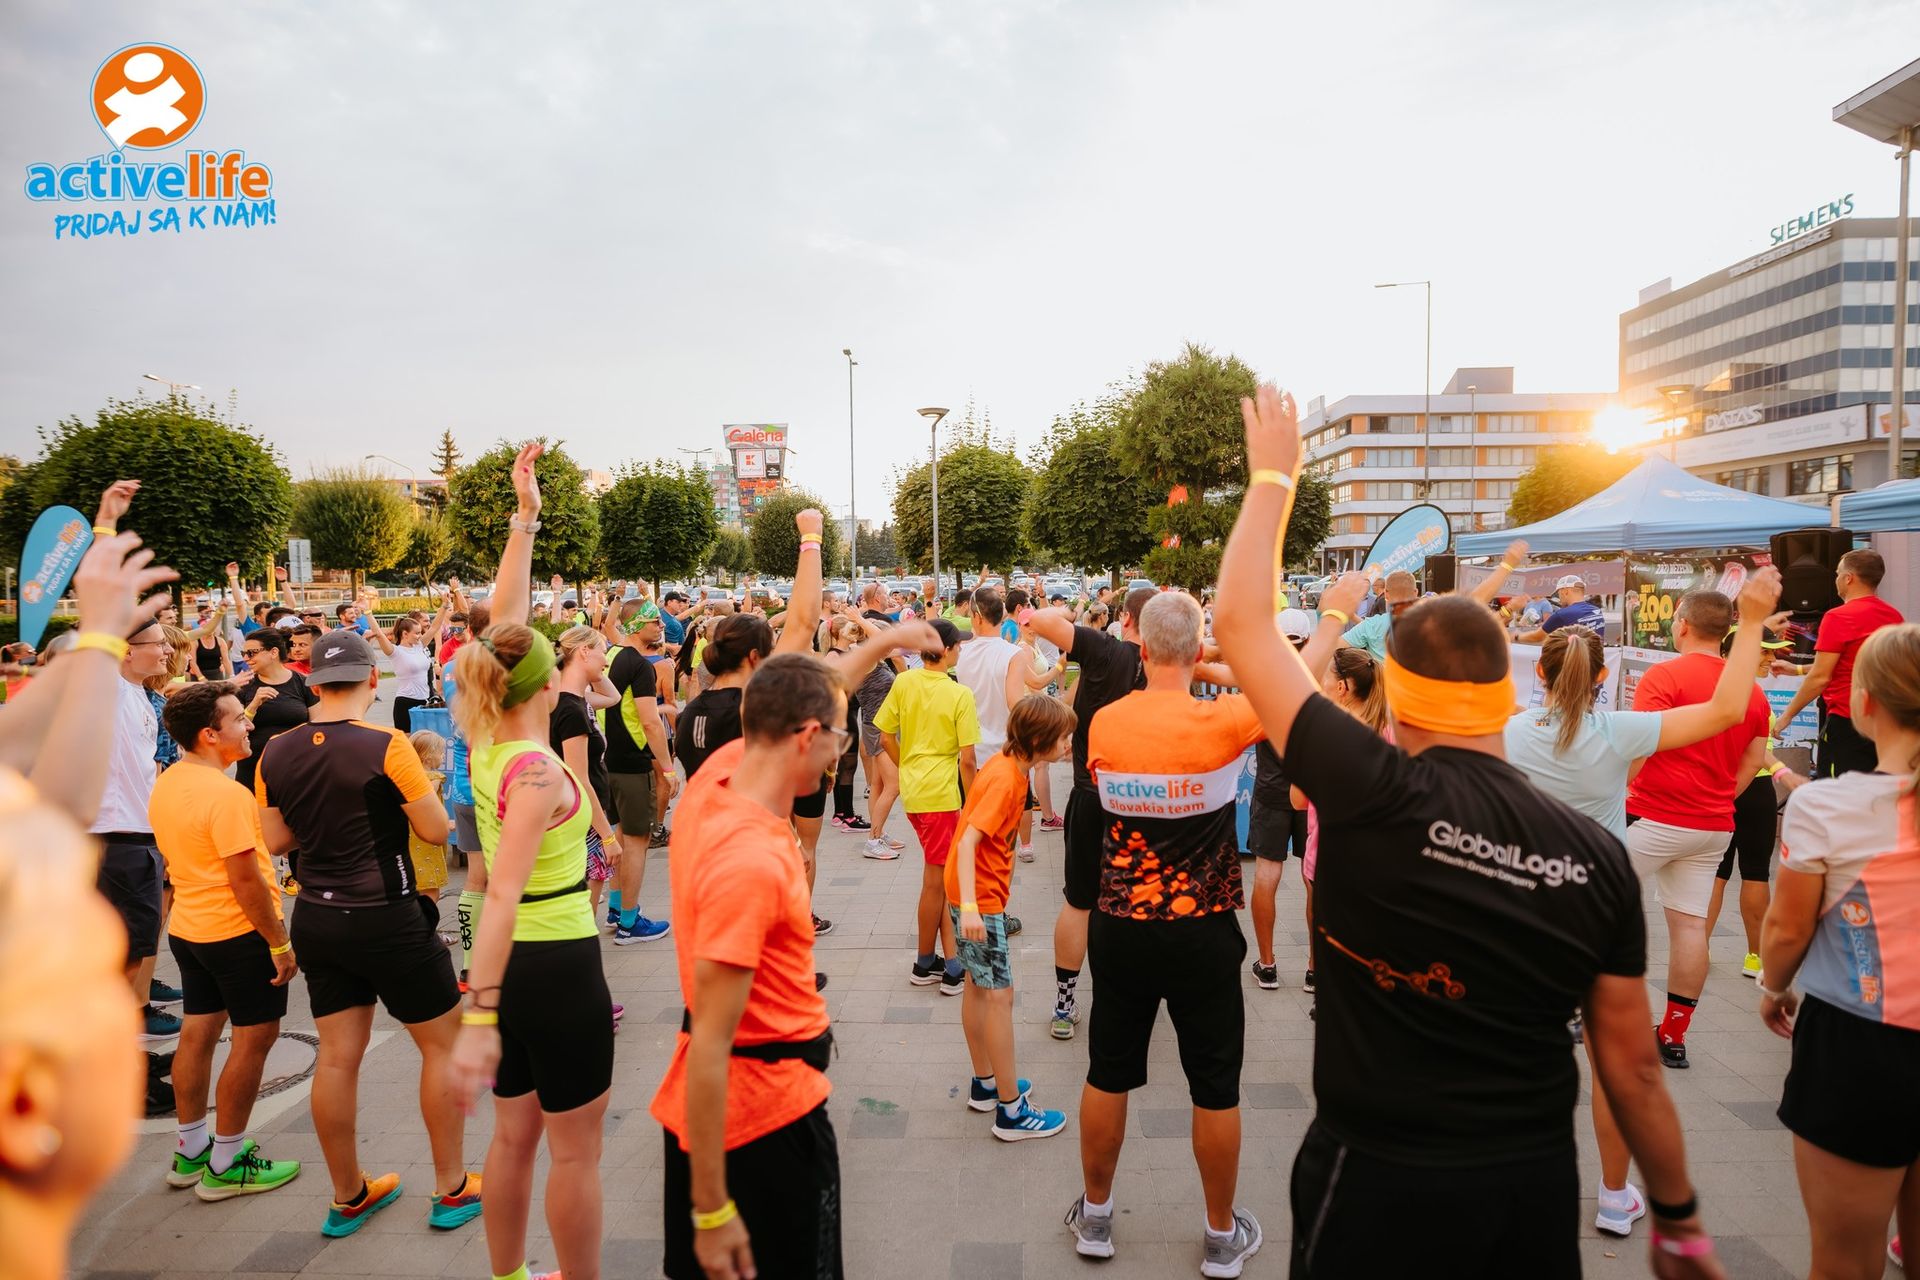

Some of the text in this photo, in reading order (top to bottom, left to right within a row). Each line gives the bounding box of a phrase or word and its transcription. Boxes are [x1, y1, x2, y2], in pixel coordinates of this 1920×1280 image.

[1770, 193, 1855, 246] SIEMENS
[1639, 594, 1674, 622] ZOO
[1107, 779, 1204, 799] activelife
[1109, 800, 1205, 815] Slovakia team
[1428, 820, 1589, 887] GlobalLogic
[1850, 928, 1881, 1004] activelife
